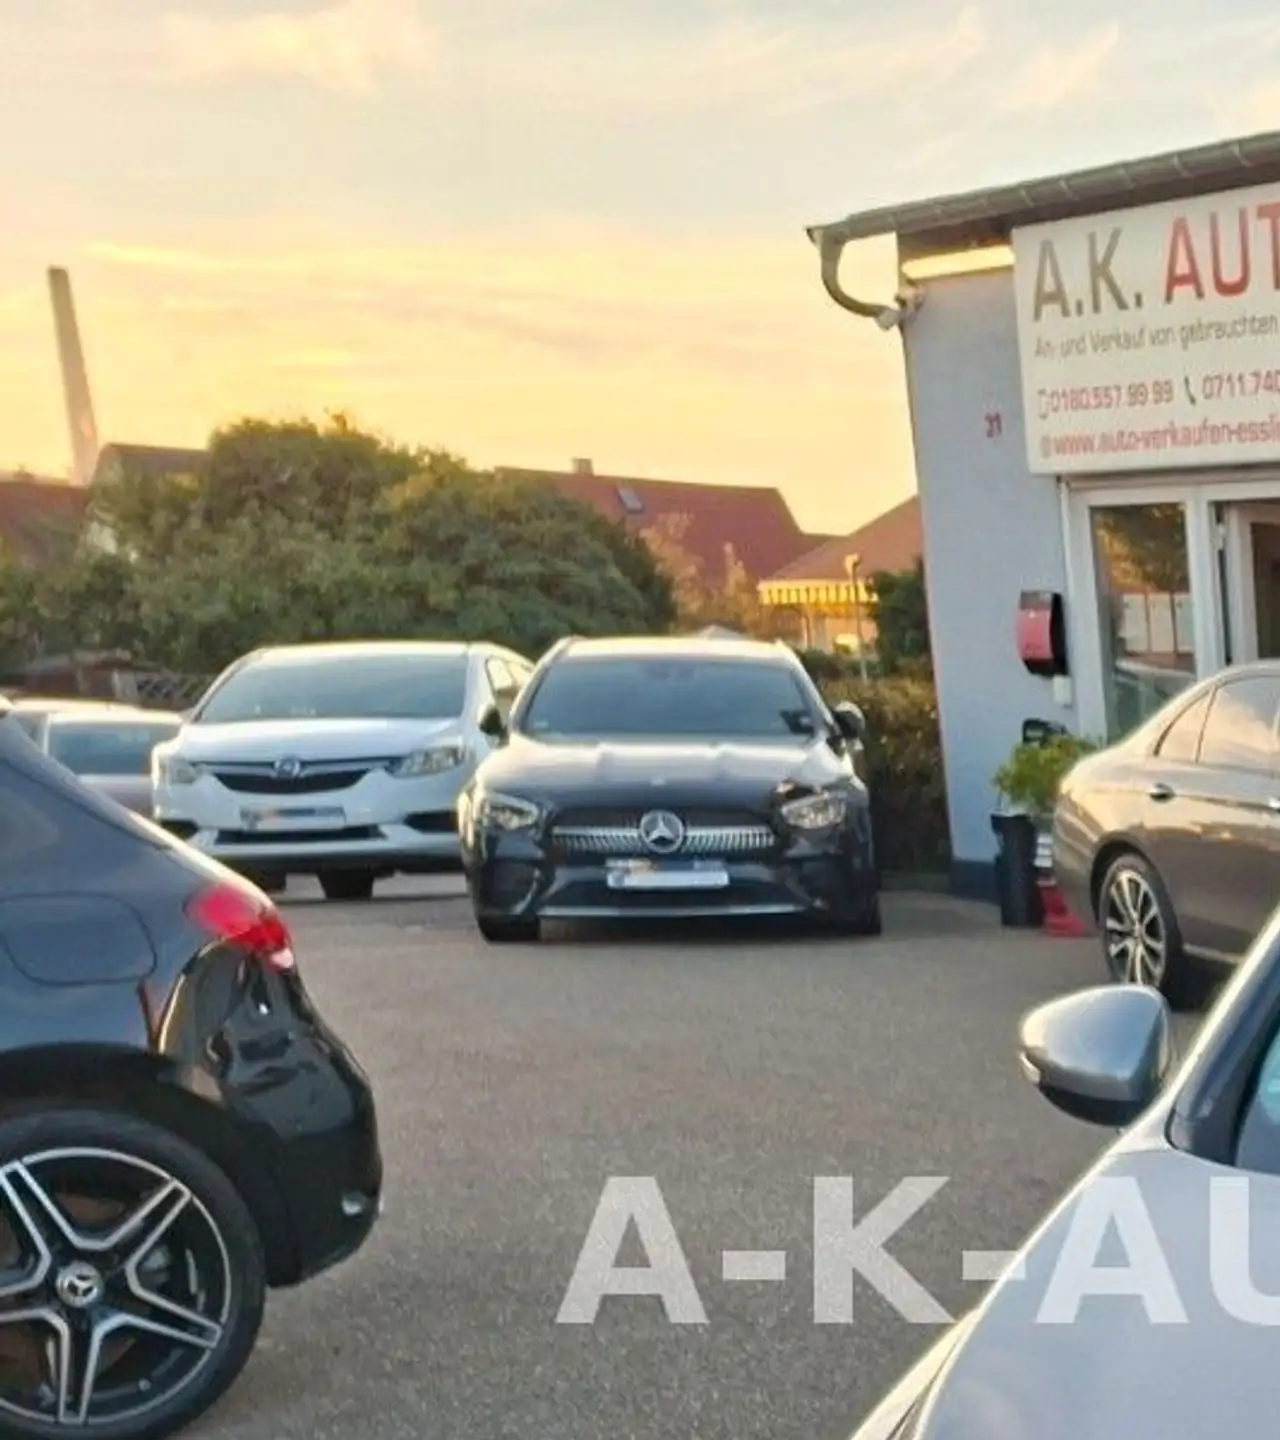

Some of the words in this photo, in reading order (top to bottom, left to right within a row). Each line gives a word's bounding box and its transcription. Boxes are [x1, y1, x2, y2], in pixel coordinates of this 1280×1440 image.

[1033, 228, 1143, 321] A.K.
[1060, 334, 1087, 357] und
[1090, 327, 1146, 353] Verkauf
[1150, 326, 1176, 346] von
[1180, 313, 1279, 351] gebrauchten
